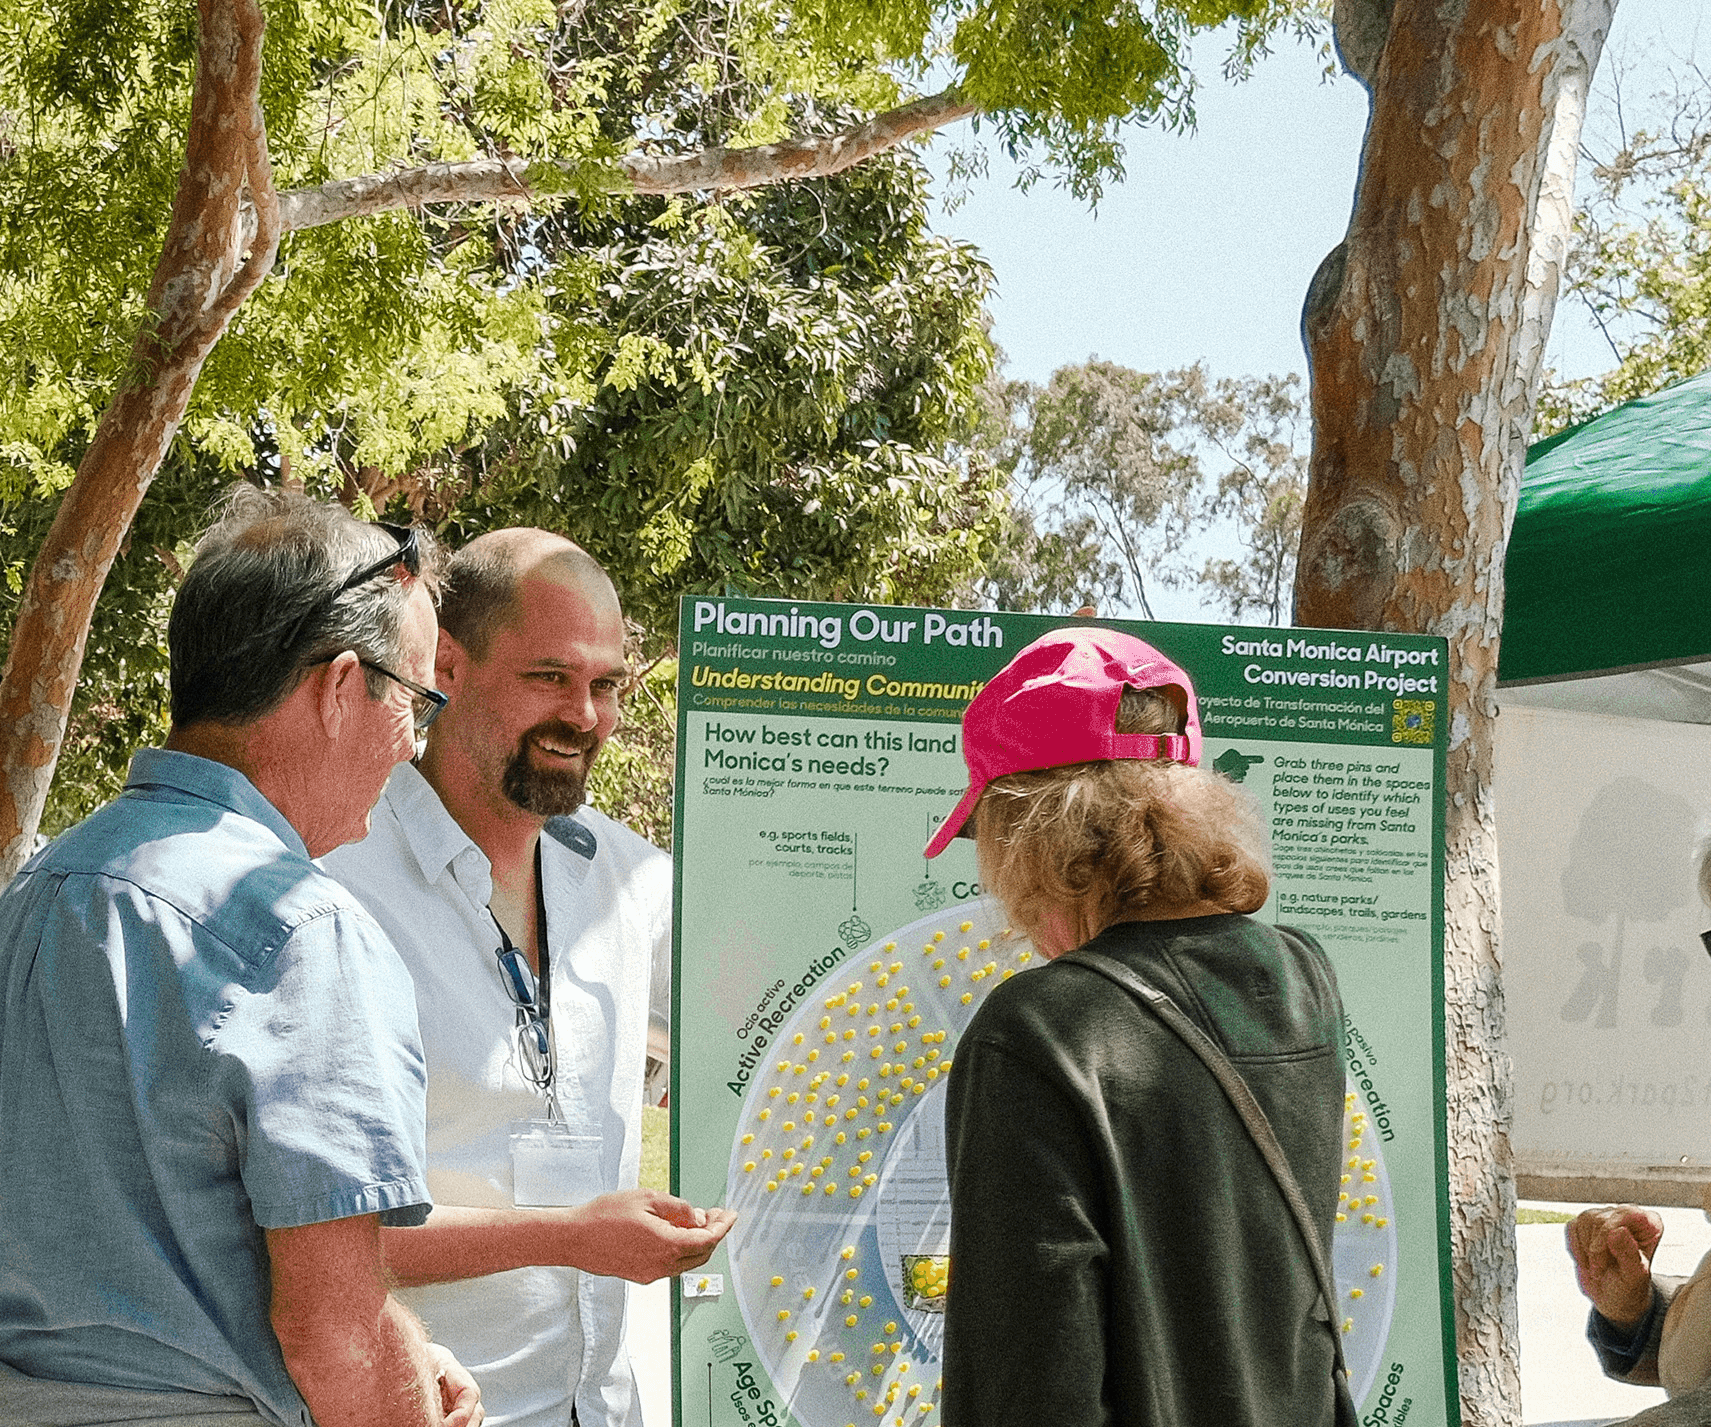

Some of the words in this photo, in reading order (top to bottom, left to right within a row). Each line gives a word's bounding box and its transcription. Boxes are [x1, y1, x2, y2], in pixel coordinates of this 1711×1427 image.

[694, 601, 841, 648] Planning
[849, 610, 916, 643] Our
[923, 613, 1003, 648] Path
[692, 641, 769, 659] Planificar
[772, 648, 833, 663] nuestro
[1221, 636, 1283, 657] Santa
[1286, 639, 1361, 662] Monica
[1365, 643, 1438, 669] Airport
[691, 665, 861, 700] Understanding
[1244, 664, 1360, 689] Conversion
[1364, 671, 1437, 696] Project
[692, 692, 774, 709] Comprender
[779, 697, 797, 709] las
[799, 699, 881, 714] necesidades
[884, 703, 901, 714] de
[903, 704, 915, 715] la
[1197, 695, 1241, 708] oyecto
[1244, 696, 1261, 708] de
[1264, 697, 1362, 714] Transformación
[1364, 703, 1385, 715] del
[1204, 712, 1277, 728] Aeropuerto
[1280, 715, 1296, 728] de
[1298, 716, 1336, 731] Santa
[1338, 718, 1384, 732] Mónica
[704, 722, 757, 743] How
[761, 725, 812, 747] best
[816, 732, 858, 748] can
[863, 731, 903, 751] this
[908, 732, 957, 754] land
[704, 748, 803, 772] Monica's
[808, 756, 890, 777] needs?
[1274, 756, 1307, 769] Grab
[1311, 759, 1344, 771] three
[1346, 761, 1372, 774] pins
[1375, 763, 1401, 774] and
[732, 778, 744, 786] es
[745, 777, 755, 787] la
[818, 781, 831, 789] en
[833, 782, 852, 792] que
[853, 783, 876, 792] este
[1272, 772, 1309, 785] place
[1313, 774, 1344, 786] them
[1347, 775, 1358, 786] in
[1362, 776, 1382, 787] the
[1386, 779, 1431, 791] spaces
[1272, 786, 1312, 798] below
[1316, 788, 1329, 799] to
[1332, 789, 1380, 804] identify
[1383, 792, 1420, 804] which
[1273, 801, 1309, 815] types
[1312, 802, 1326, 813] of
[1328, 805, 1356, 816] uses
[1360, 807, 1382, 818] you
[1385, 806, 1410, 818] feel
[1272, 817, 1294, 827] are
[1297, 818, 1344, 832] missing
[1346, 819, 1376, 831] from
[1379, 820, 1416, 833] Santa
[781, 831, 818, 843] sports
[1330, 833, 1369, 846] parks.
[775, 843, 815, 855] courts,
[817, 843, 853, 855] tracks
[1301, 893, 1338, 904] nature
[1340, 895, 1379, 905] parks/
[1381, 910, 1427, 921] gardens
[736, 1013, 759, 1039] Ocio
[757, 979, 786, 1013] activo
[726, 1035, 768, 1098] Active
[758, 947, 846, 1035] Recreation
[1348, 1027, 1377, 1065] pasivo
[732, 1362, 761, 1400] Age
[730, 1391, 751, 1422] Usos
